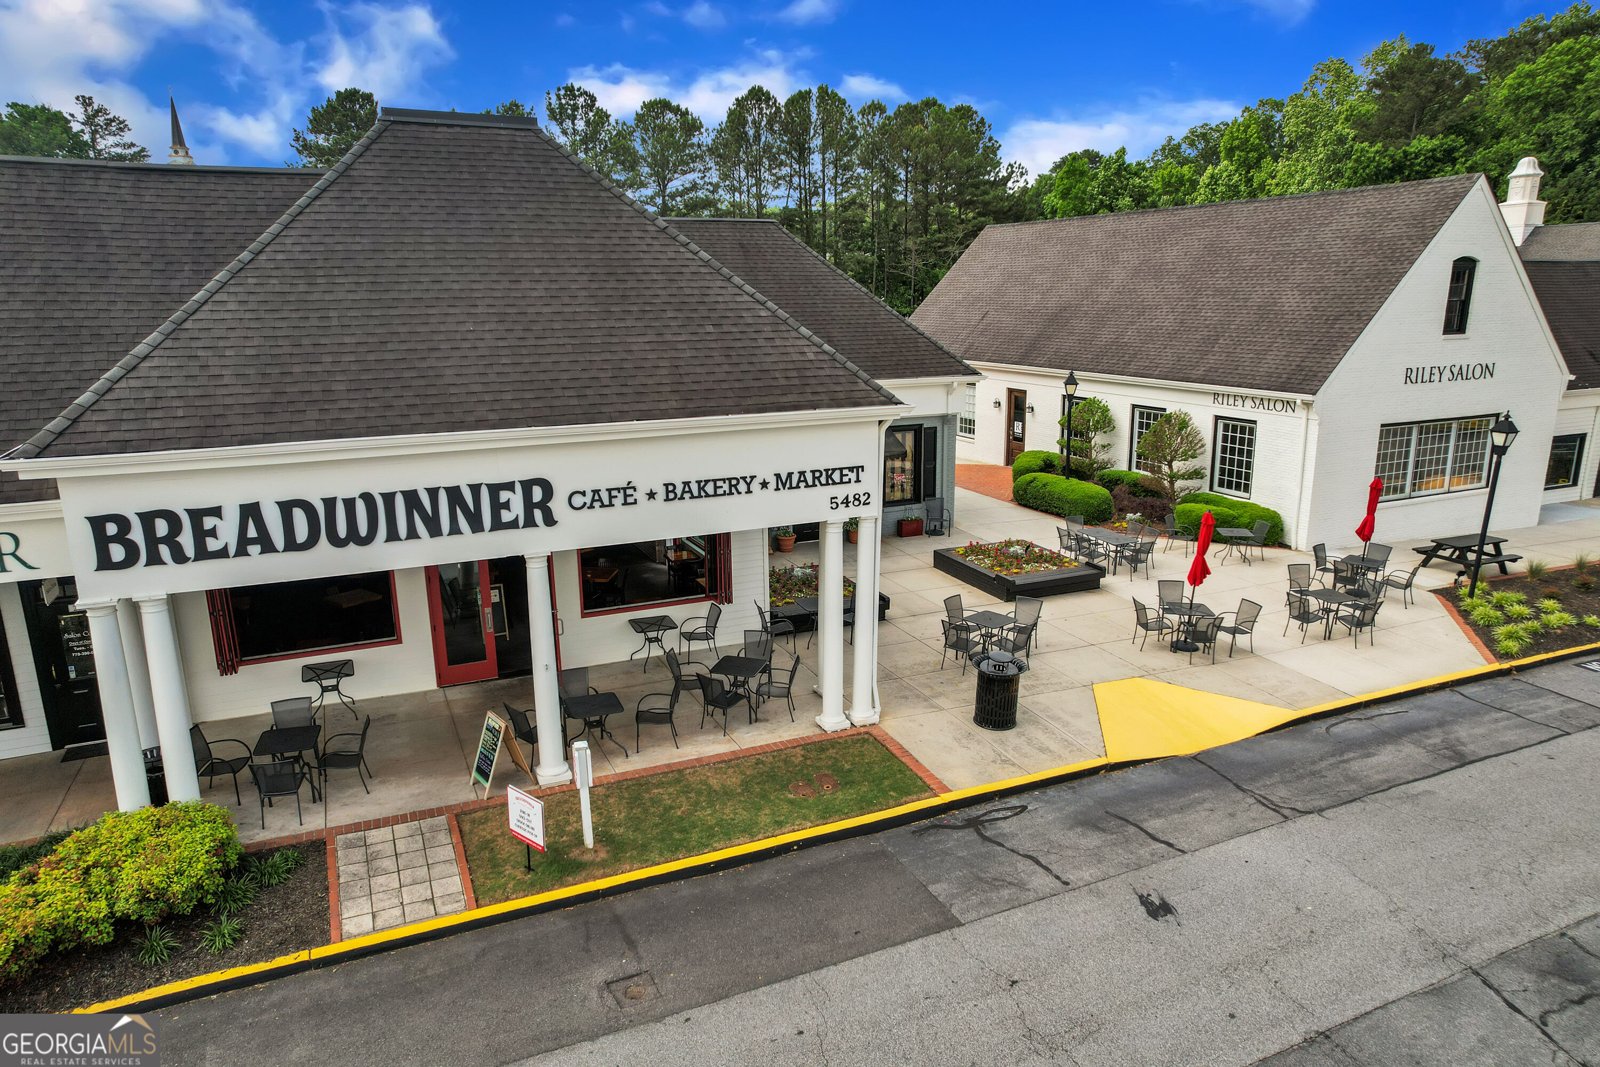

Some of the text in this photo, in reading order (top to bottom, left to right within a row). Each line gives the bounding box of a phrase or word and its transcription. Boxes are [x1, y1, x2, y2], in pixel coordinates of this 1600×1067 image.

[1404, 362, 1496, 385] RILEY SALON
[1213, 392, 1297, 413] RILEY SALON
[568, 465, 865, 511] CAFÉ BAKERY MARKET
[830, 491, 871, 511] 5482
[84, 477, 558, 571] BREADWINNER
